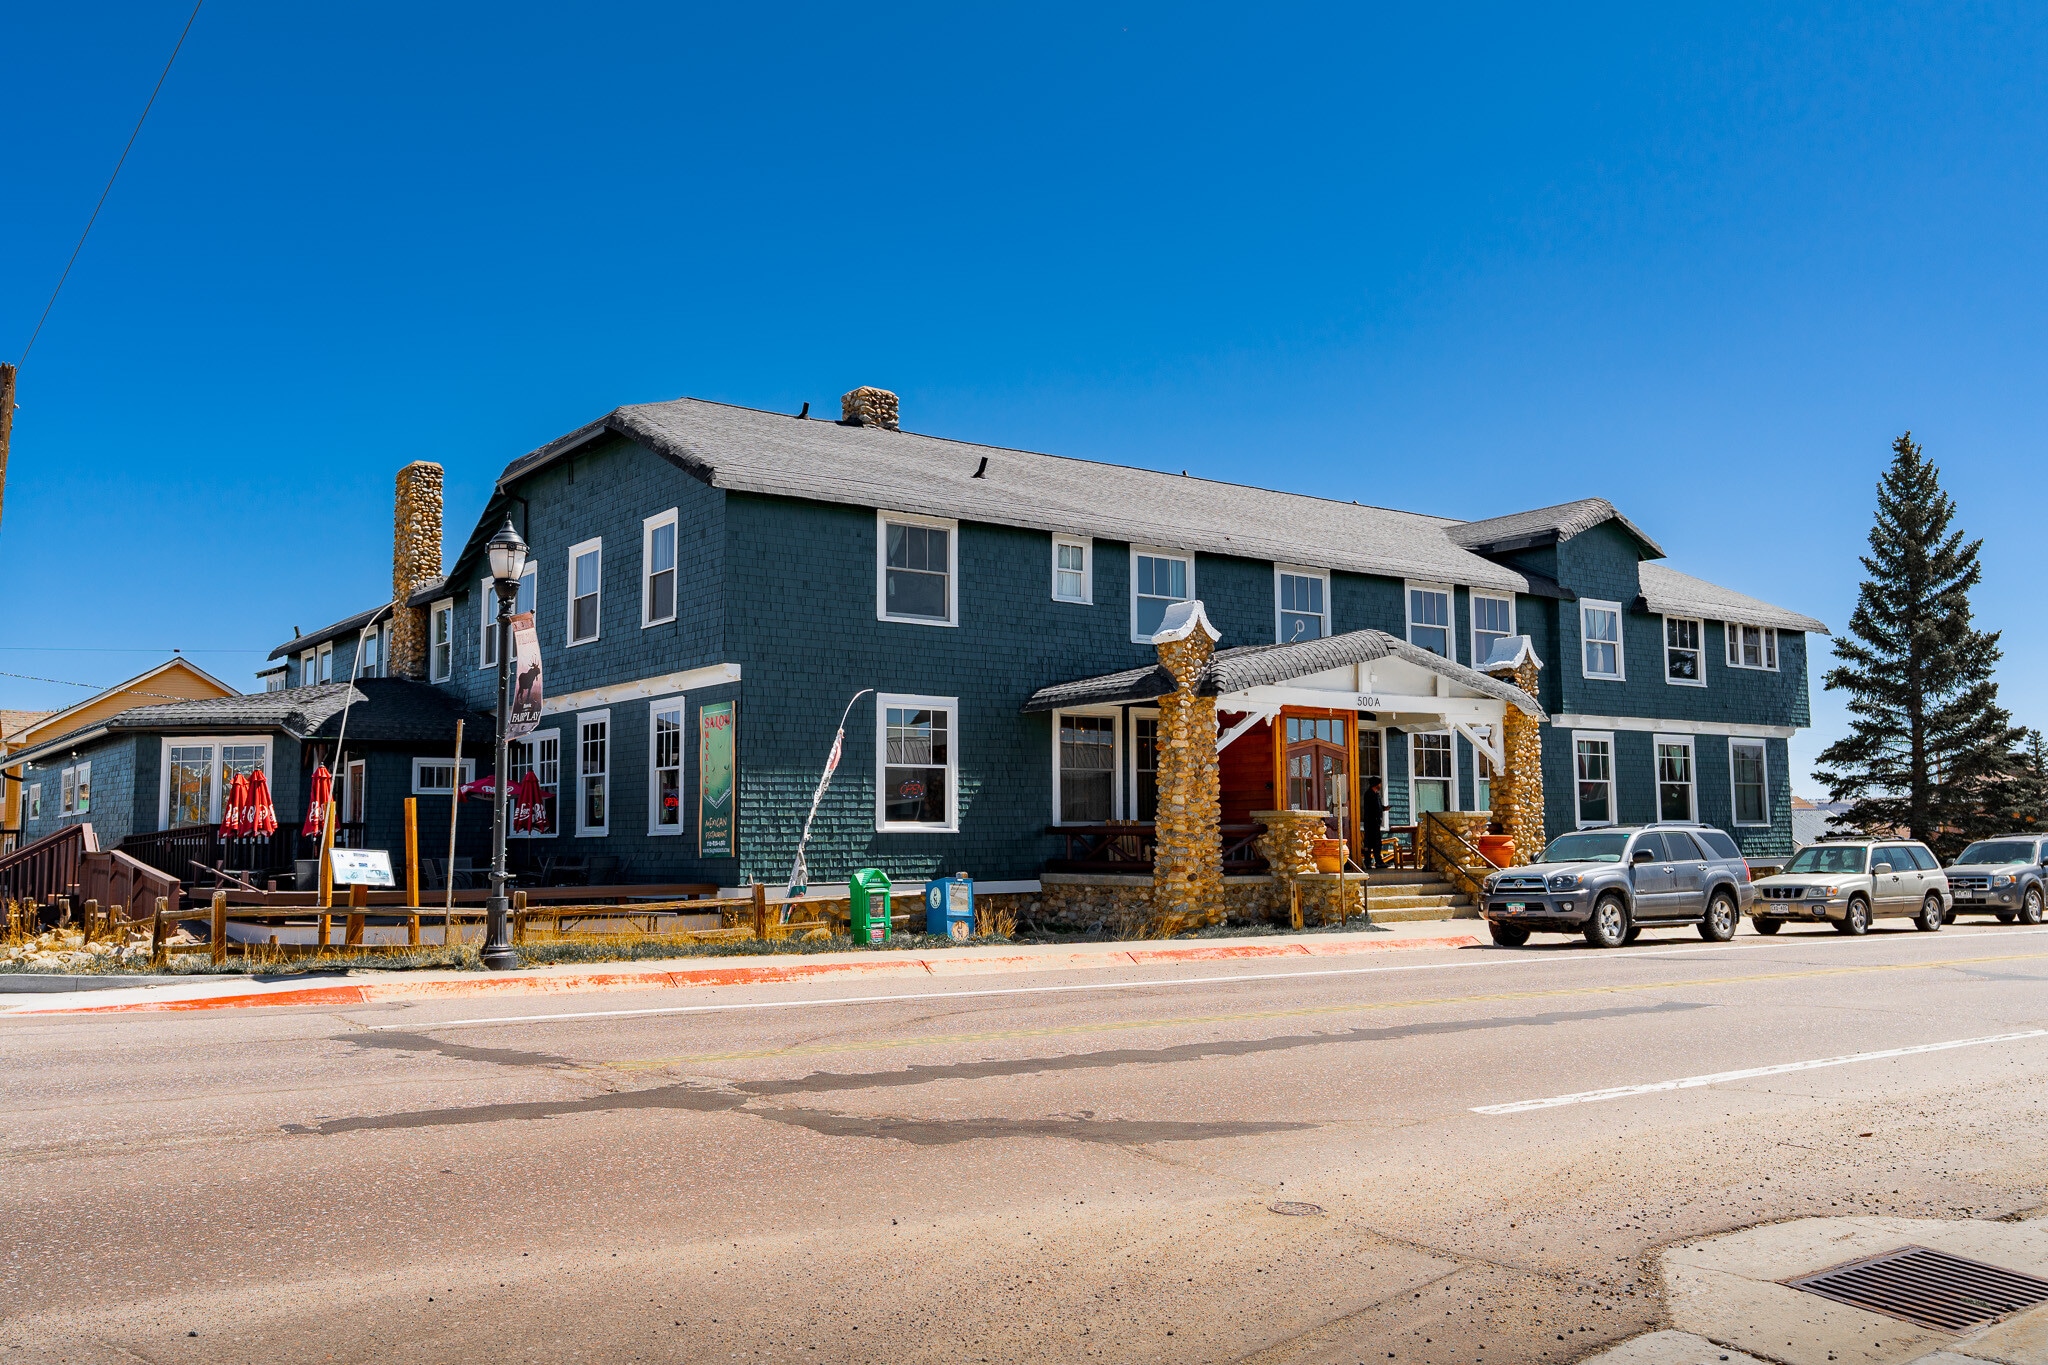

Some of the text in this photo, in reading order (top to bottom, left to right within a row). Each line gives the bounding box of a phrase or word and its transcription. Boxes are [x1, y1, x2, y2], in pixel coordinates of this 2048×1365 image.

[511, 711, 541, 723] FAIRPLAY
[704, 713, 731, 731] SALON
[900, 783, 925, 795] OPEN
[663, 797, 679, 807] OPEN
[705, 816, 728, 829] MEXICAN
